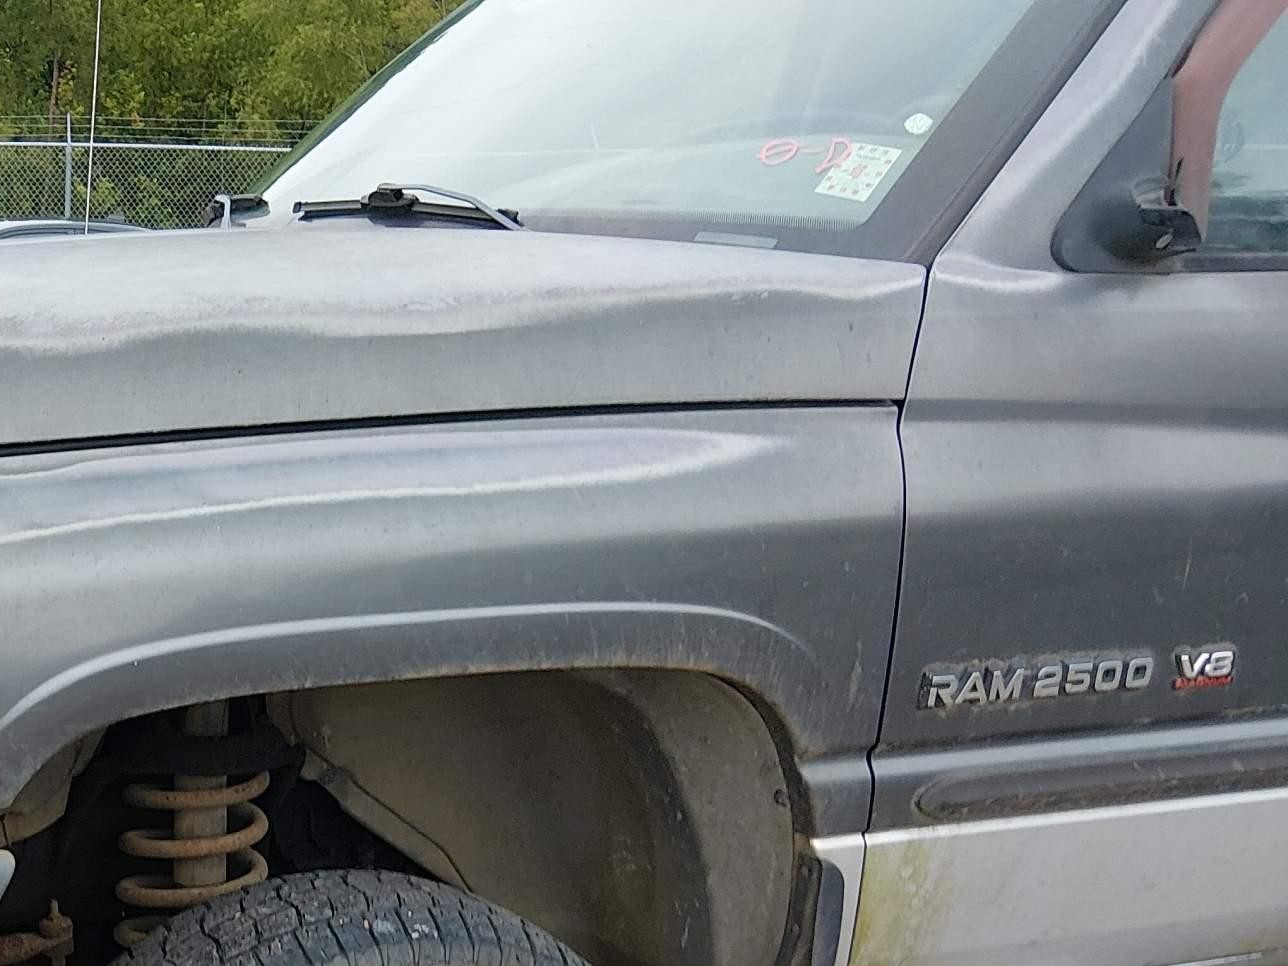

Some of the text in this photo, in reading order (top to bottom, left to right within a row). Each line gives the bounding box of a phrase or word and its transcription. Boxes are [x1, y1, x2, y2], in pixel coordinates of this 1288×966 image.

[925, 656, 1154, 709] RAM 2500
[1179, 650, 1234, 680] V8
